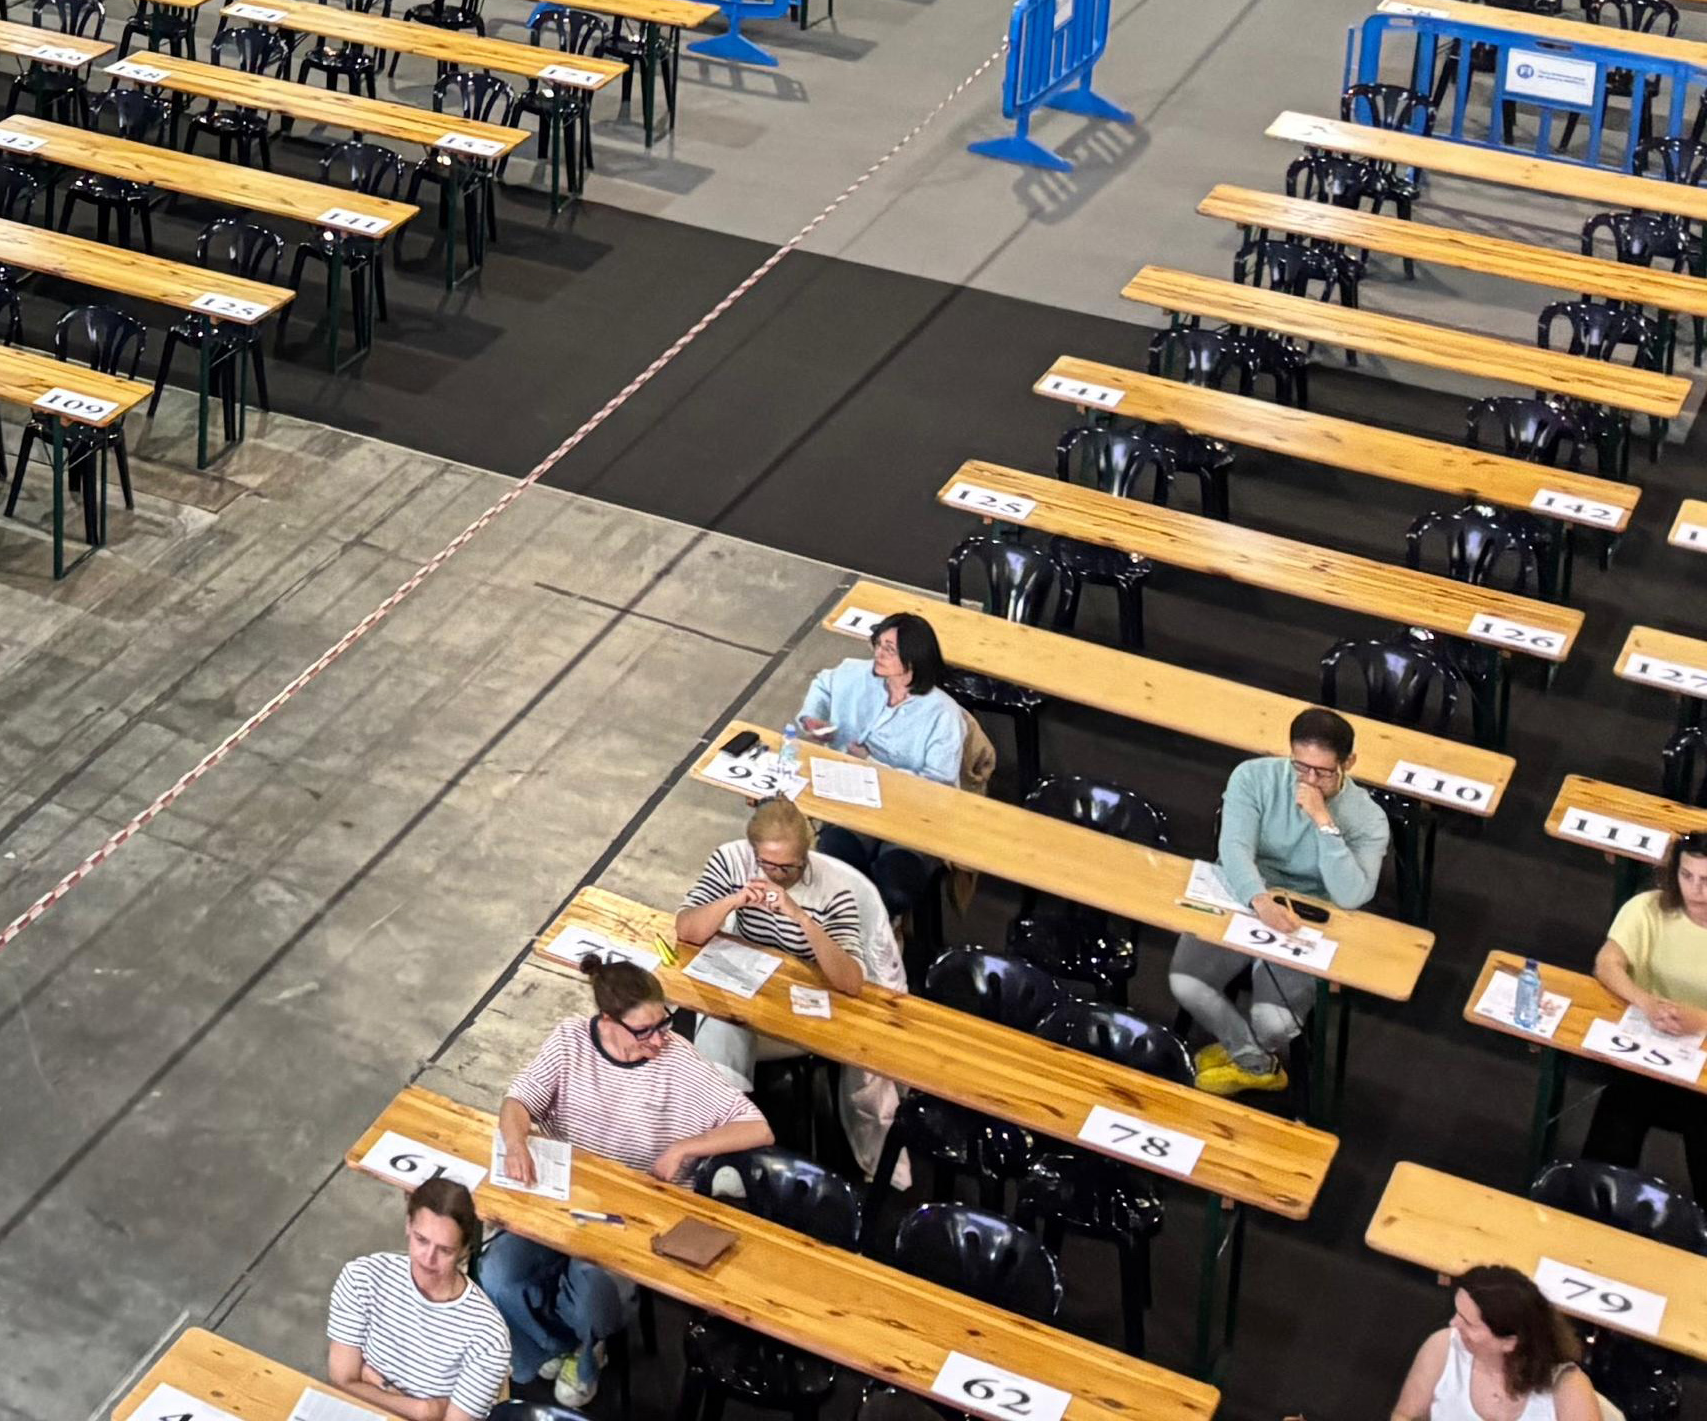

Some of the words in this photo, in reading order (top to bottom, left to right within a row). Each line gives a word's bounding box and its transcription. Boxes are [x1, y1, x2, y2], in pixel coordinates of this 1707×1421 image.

[329, 213, 376, 228] 141
[204, 298, 253, 315] 125
[1053, 381, 1109, 401] 141
[44, 395, 104, 414] 109
[959, 489, 1021, 513] 125
[1546, 497, 1612, 519] 142
[1484, 622, 1554, 648] 126
[728, 765, 778, 790] 93
[1405, 772, 1483, 800] 110
[1576, 818, 1650, 851] 111
[1610, 1036, 1672, 1066] 95
[1110, 1124, 1170, 1157] 78
[390, 1154, 447, 1180] 61
[1564, 1278, 1633, 1313] 79
[963, 1379, 1030, 1415] 62
